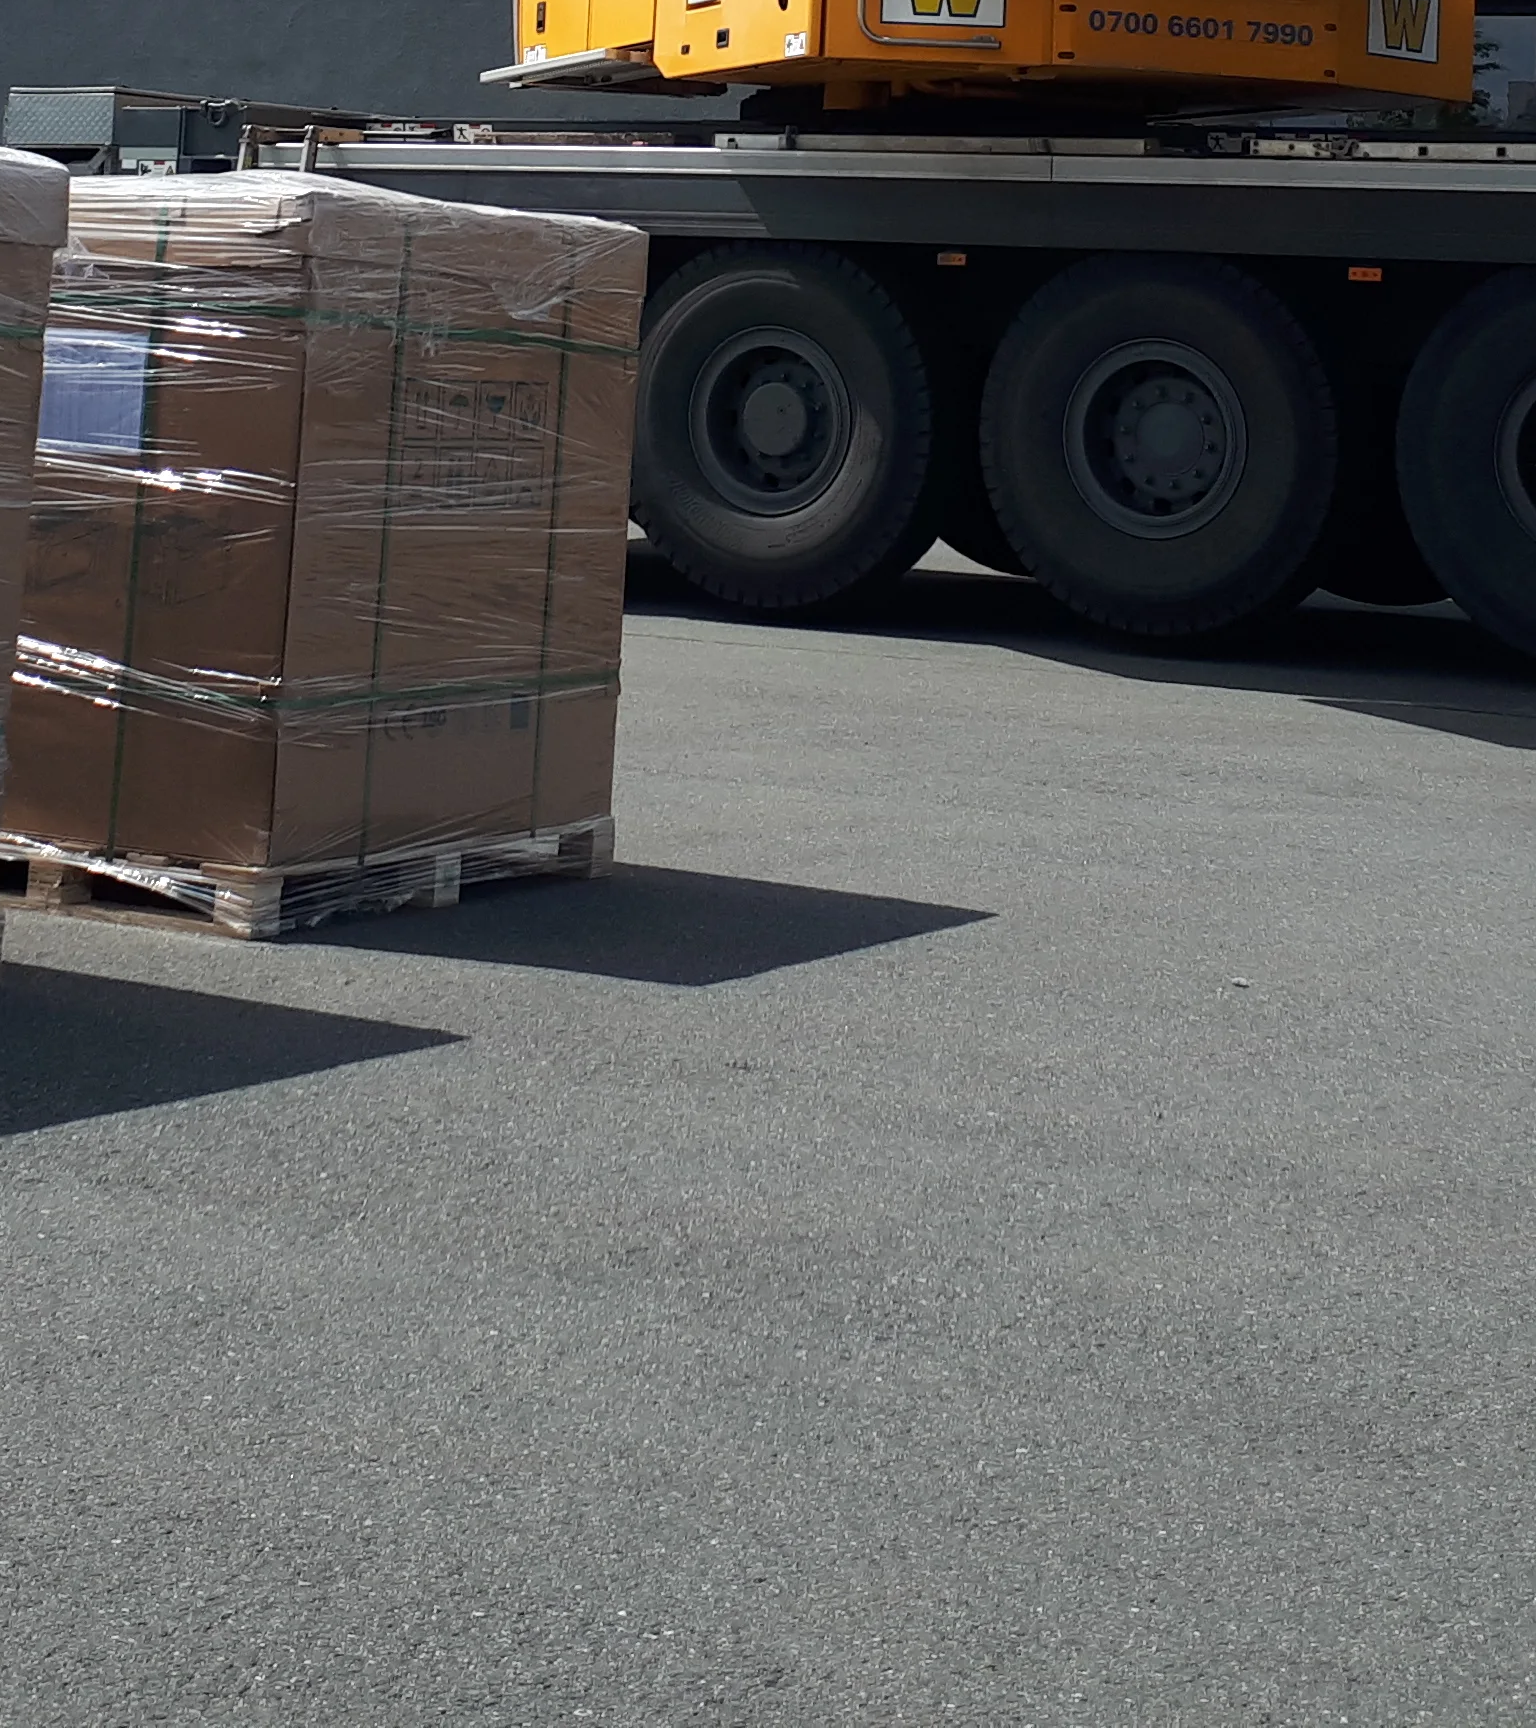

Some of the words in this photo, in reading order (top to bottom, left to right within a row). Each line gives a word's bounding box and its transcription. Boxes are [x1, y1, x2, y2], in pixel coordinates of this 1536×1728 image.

[1088, 9, 1159, 35] 0700
[1167, 15, 1235, 40] 6601
[1246, 20, 1314, 47] 7990
